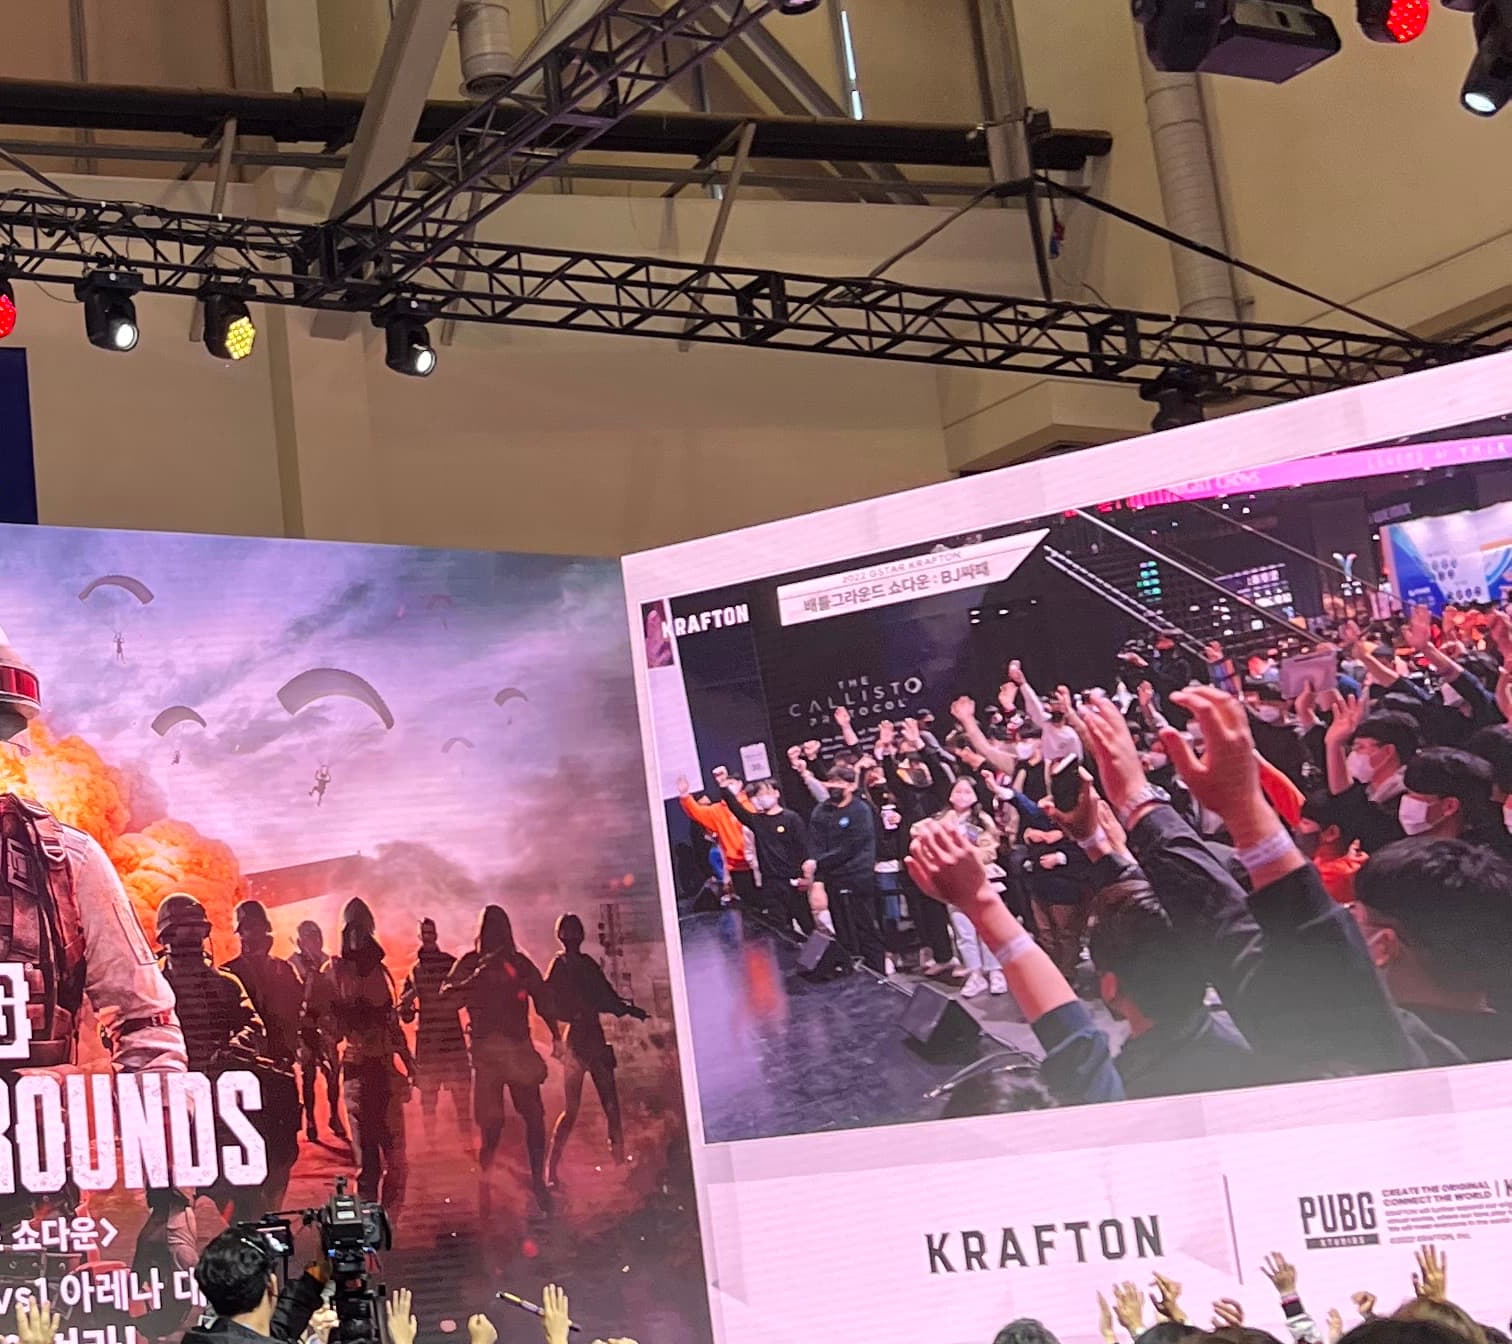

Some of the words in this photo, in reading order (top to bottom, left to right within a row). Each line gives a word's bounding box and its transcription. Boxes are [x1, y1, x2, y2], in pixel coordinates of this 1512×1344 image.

[662, 603, 749, 638] KRAFTON
[1382, 1186, 1419, 1197] CREATE
[1421, 1184, 1439, 1193] THE
[1441, 1181, 1490, 1192] ORIGINAL
[1383, 1196, 1431, 1207] CONNECT
[1433, 1194, 1452, 1202] THE
[1454, 1191, 1492, 1200] WORLD
[1298, 1191, 1377, 1234] PUBG
[926, 1215, 1164, 1274] KRAFTON
[59, 1267, 164, 1314] 아레나
